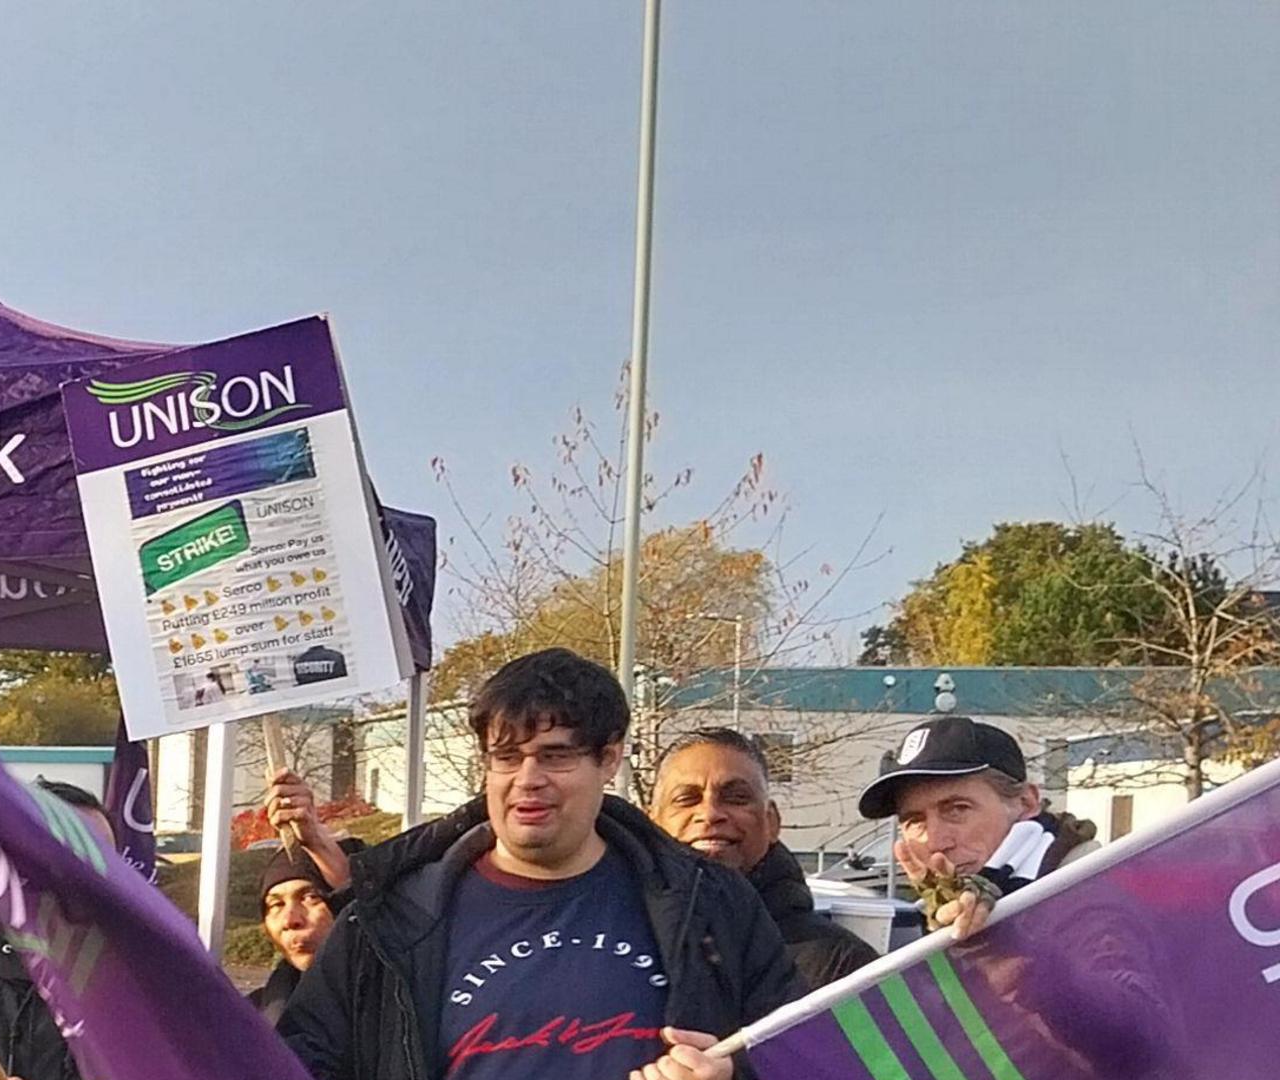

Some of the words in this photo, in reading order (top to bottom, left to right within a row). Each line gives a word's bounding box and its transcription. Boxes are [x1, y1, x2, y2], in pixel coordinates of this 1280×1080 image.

[108, 364, 298, 449] UNISON
[256, 496, 315, 518] UNISON
[157, 525, 238, 572] STRIKE!
[288, 537, 309, 550] Pay
[311, 534, 324, 543] us
[235, 560, 262, 573] what
[263, 555, 286, 568] you
[287, 550, 311, 562] owe
[313, 546, 327, 556] us
[222, 581, 263, 598] Serco
[162, 613, 211, 632] Putting
[249, 595, 293, 612] million
[294, 586, 332, 606] profit
[234, 621, 266, 636] over
[215, 643, 252, 661] lump
[251, 638, 281, 652] sum
[282, 632, 302, 646] for
[303, 625, 335, 641] staff
